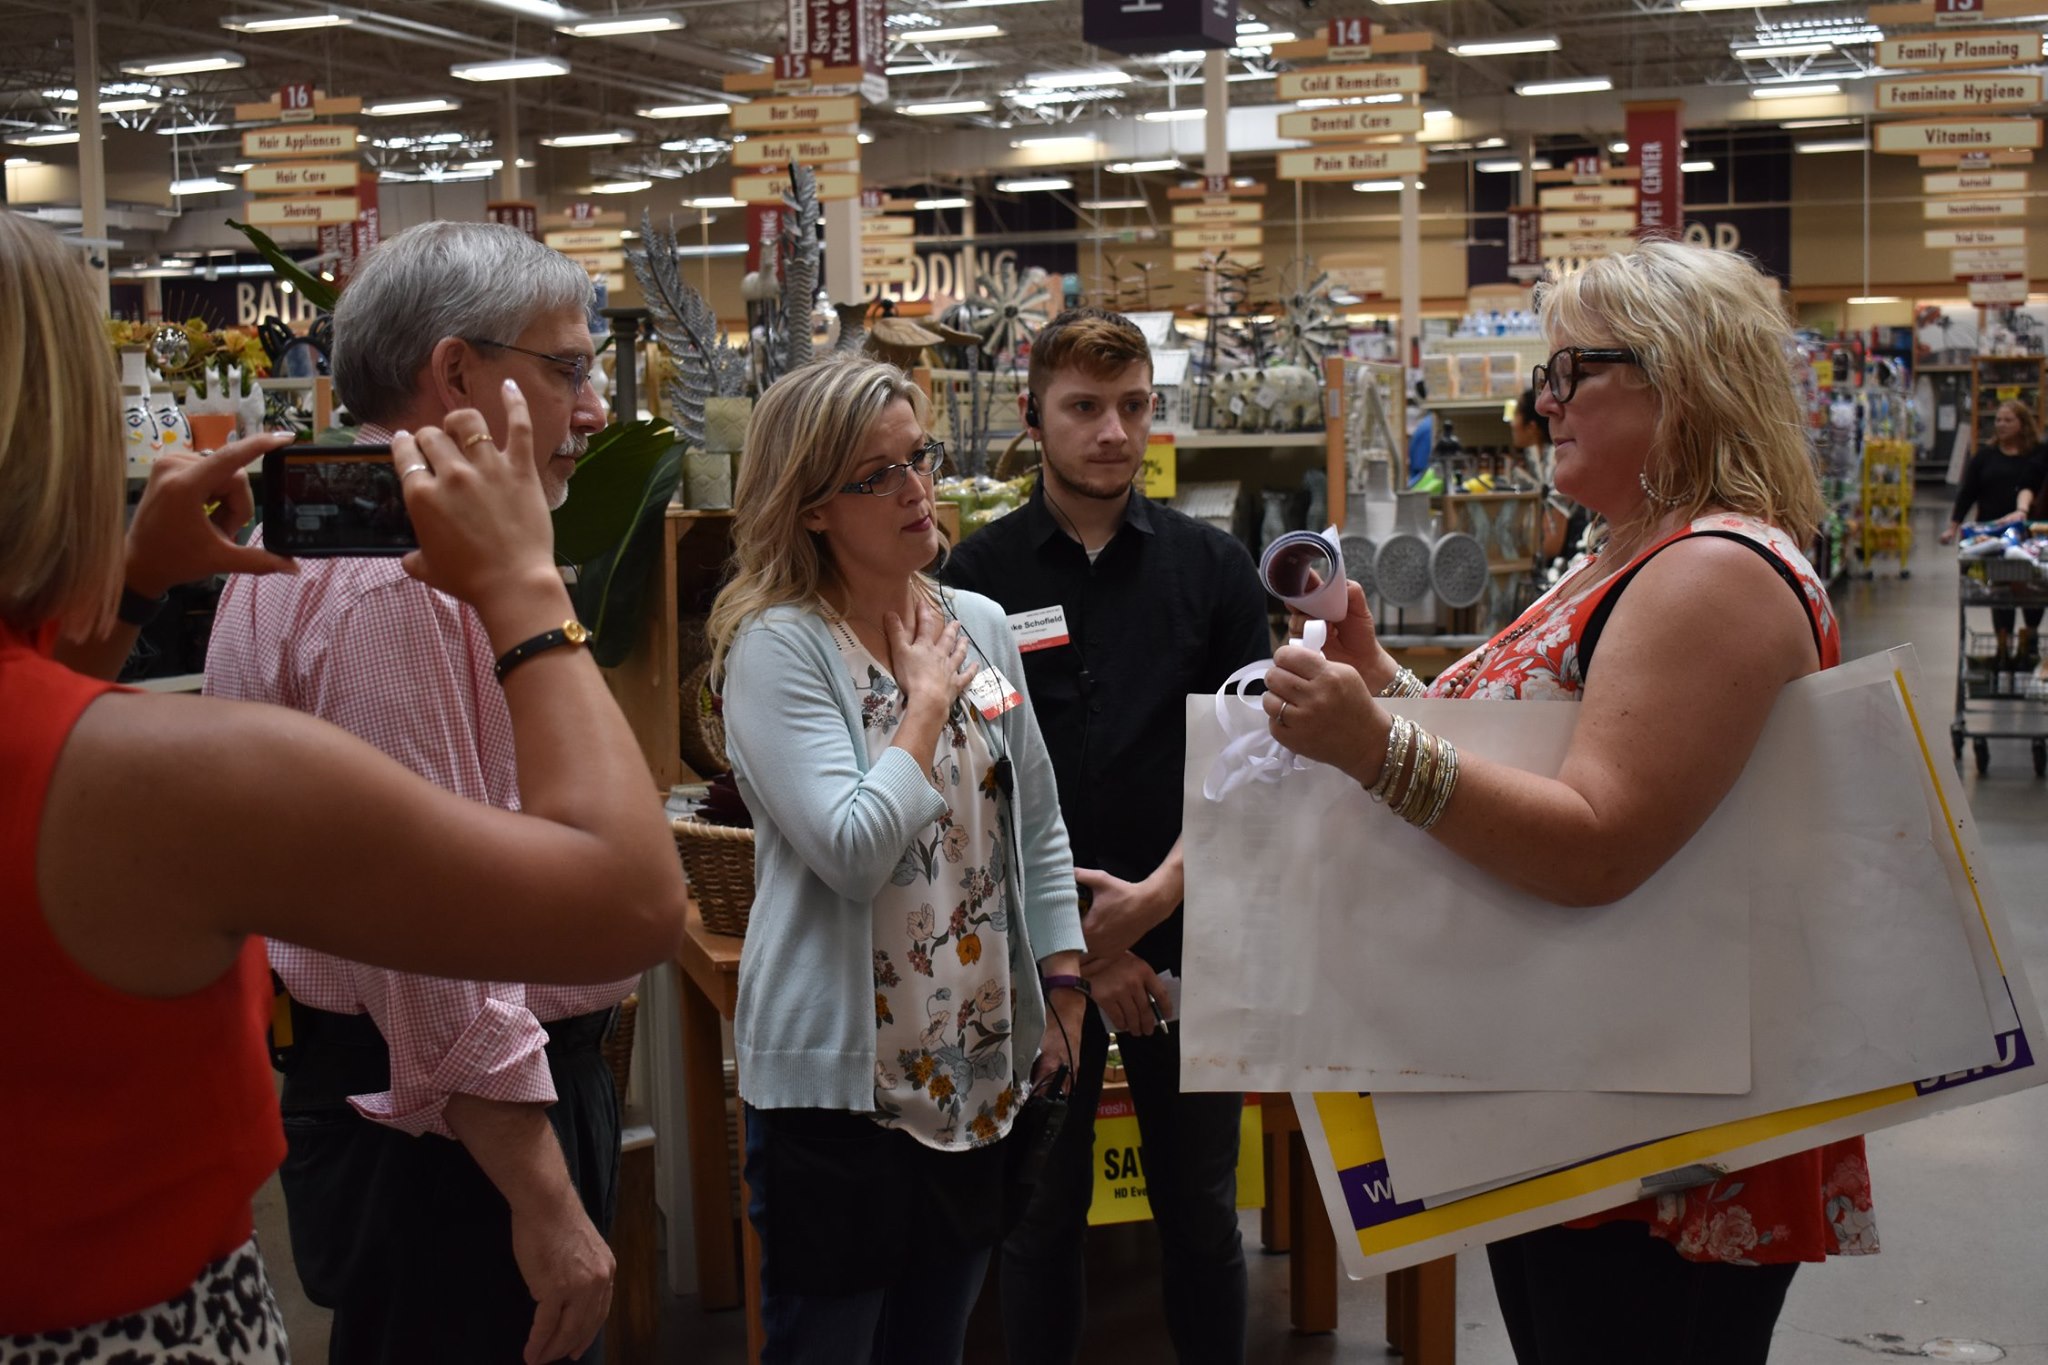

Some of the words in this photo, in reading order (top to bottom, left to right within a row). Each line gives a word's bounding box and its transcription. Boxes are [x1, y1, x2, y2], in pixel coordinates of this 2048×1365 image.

[1336, 20, 1362, 45] 14
[1897, 42, 1946, 61] Family
[1954, 40, 2019, 60] Planning
[782, 55, 806, 78] 15
[1301, 75, 1331, 91] Cold
[1336, 73, 1400, 89] Remedies
[287, 85, 309, 108] 16
[1891, 85, 1956, 102] Feminine
[1964, 82, 2025, 103] Hygiene
[770, 106, 789, 120] Bar
[792, 105, 819, 120] Soap
[1311, 114, 1354, 131] Dental
[1360, 112, 1391, 128] Care
[258, 136, 279, 149] Hair
[285, 134, 342, 150] Appliances
[1924, 127, 1992, 144] Vitamins
[762, 145, 791, 158] Body
[797, 143, 830, 156] Wash
[1314, 155, 1342, 170] Pain
[1348, 152, 1388, 168] Relief
[1577, 157, 1598, 175] 14
[1641, 140, 1663, 194] CENTER
[276, 171, 297, 183] Hair
[302, 169, 327, 182] Care
[283, 204, 322, 218] Shaving
[863, 250, 1017, 303] DDIN
[1024, 615, 1063, 629] Schofield
[1097, 1102, 1127, 1115] resh
[1114, 1187, 1128, 1199] HD
